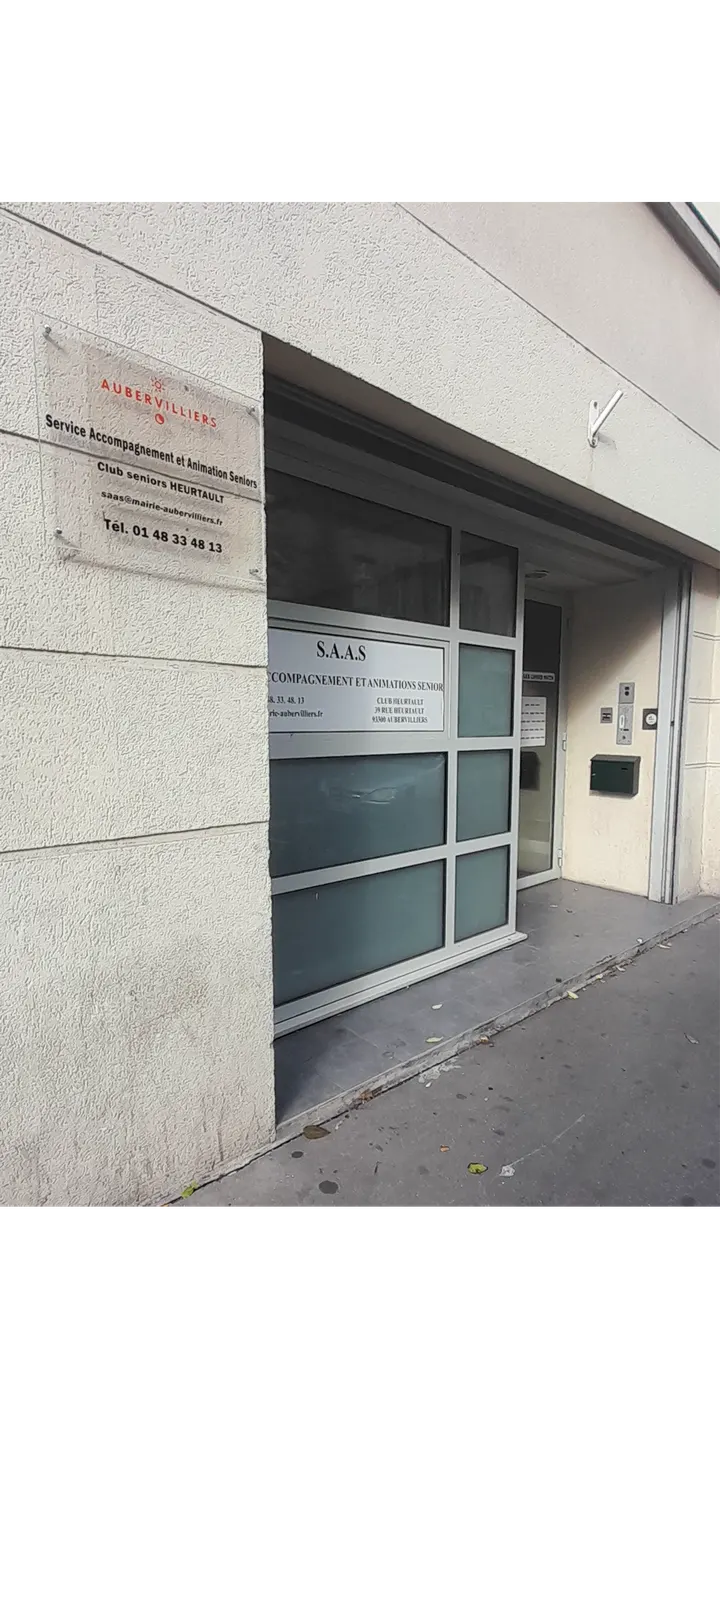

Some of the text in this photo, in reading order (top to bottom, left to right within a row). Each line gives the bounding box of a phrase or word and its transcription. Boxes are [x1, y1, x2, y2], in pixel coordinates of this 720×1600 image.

[101, 379, 217, 428] AUBERVILLIERS
[45, 414, 257, 489] Service Accompagnement et Animation Seniors
[97, 461, 224, 504] Club seniors HEURTAULT
[101, 490, 223, 526] saas@mairie-aubervilliers.fr
[103, 518, 223, 554] Tél. 01 48 33 48 13
[316, 640, 367, 662] S.A.A.S
[355, 677, 366, 687] ET
[367, 678, 416, 690] ANIMATIONS
[376, 697, 424, 706] CLUB HEURTAULT
